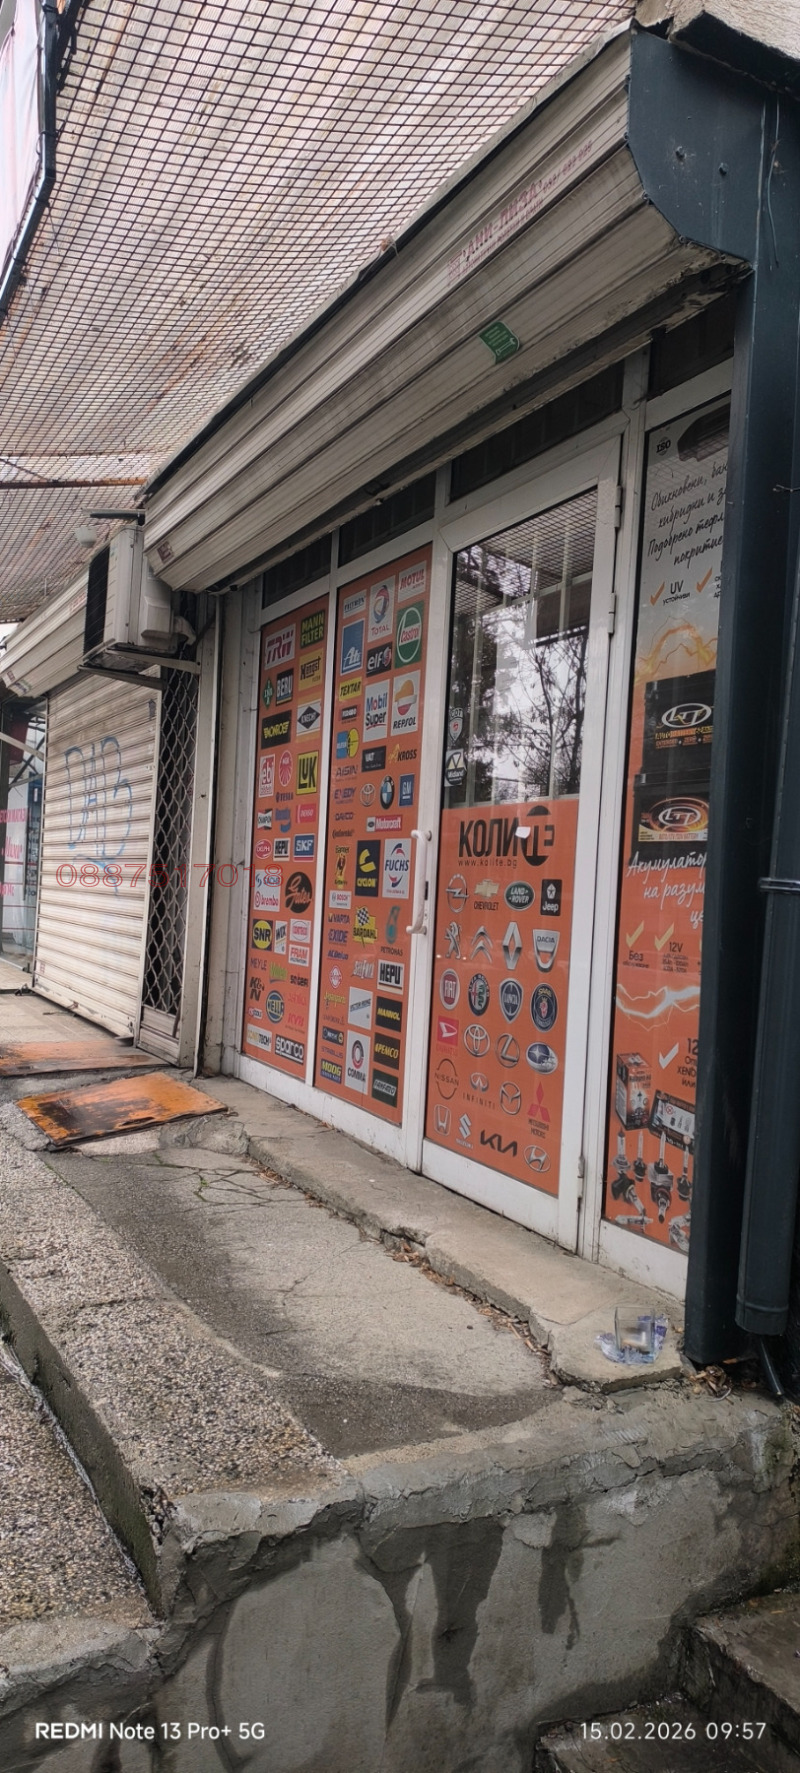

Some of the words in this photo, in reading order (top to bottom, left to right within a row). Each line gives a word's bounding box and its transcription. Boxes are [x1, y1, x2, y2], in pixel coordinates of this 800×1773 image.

[656, 440, 671, 453] ISO
[400, 569, 425, 590] MOTUL
[670, 580, 684, 594] UV
[302, 613, 324, 632] MANN
[301, 628, 324, 647] FILTER
[371, 626, 390, 637] TOTAL
[401, 626, 420, 643] Castrol
[267, 630, 294, 664] TRW
[367, 651, 383, 669] elf
[277, 675, 293, 698] BERU
[340, 681, 361, 697] TEXTAR
[366, 692, 388, 713] Mobil
[365, 711, 387, 727] Super
[393, 716, 417, 730] REPSOL
[264, 721, 290, 739] MONROE
[397, 749, 417, 761] KROSS
[275, 840, 288, 855] HEPU
[296, 840, 313, 852] SKF
[385, 859, 409, 872] FUCHS
[458, 858, 517, 868] www.kolite.bg
[336, 892, 350, 902] BOSCH
[510, 886, 526, 896] LAND
[643, 885, 659, 898] на
[261, 895, 279, 907] brembo
[473, 901, 499, 911] CHEVROLET
[511, 894, 529, 905] ROVER
[542, 902, 559, 913] Jeep
[253, 928, 271, 942] SNR
[329, 930, 349, 943] EXIDE
[353, 927, 377, 940] BARDAHL
[537, 935, 556, 944] DACIA
[290, 947, 307, 958] FRAM
[381, 946, 404, 957] PETRONAS
[669, 942, 684, 953] 12V
[629, 950, 644, 962] Без
[250, 957, 268, 972] MEYLE
[380, 962, 401, 985] HEPU
[444, 979, 457, 999] FIAT
[377, 1007, 400, 1021] MANNOL
[275, 1035, 304, 1060] sparco
[378, 1043, 399, 1059] PEMCO
[321, 1062, 341, 1077] MOOG
[434, 1073, 459, 1087] NISSAN
[462, 1092, 497, 1110] INFINITI
[530, 1127, 547, 1139] MOTORS
